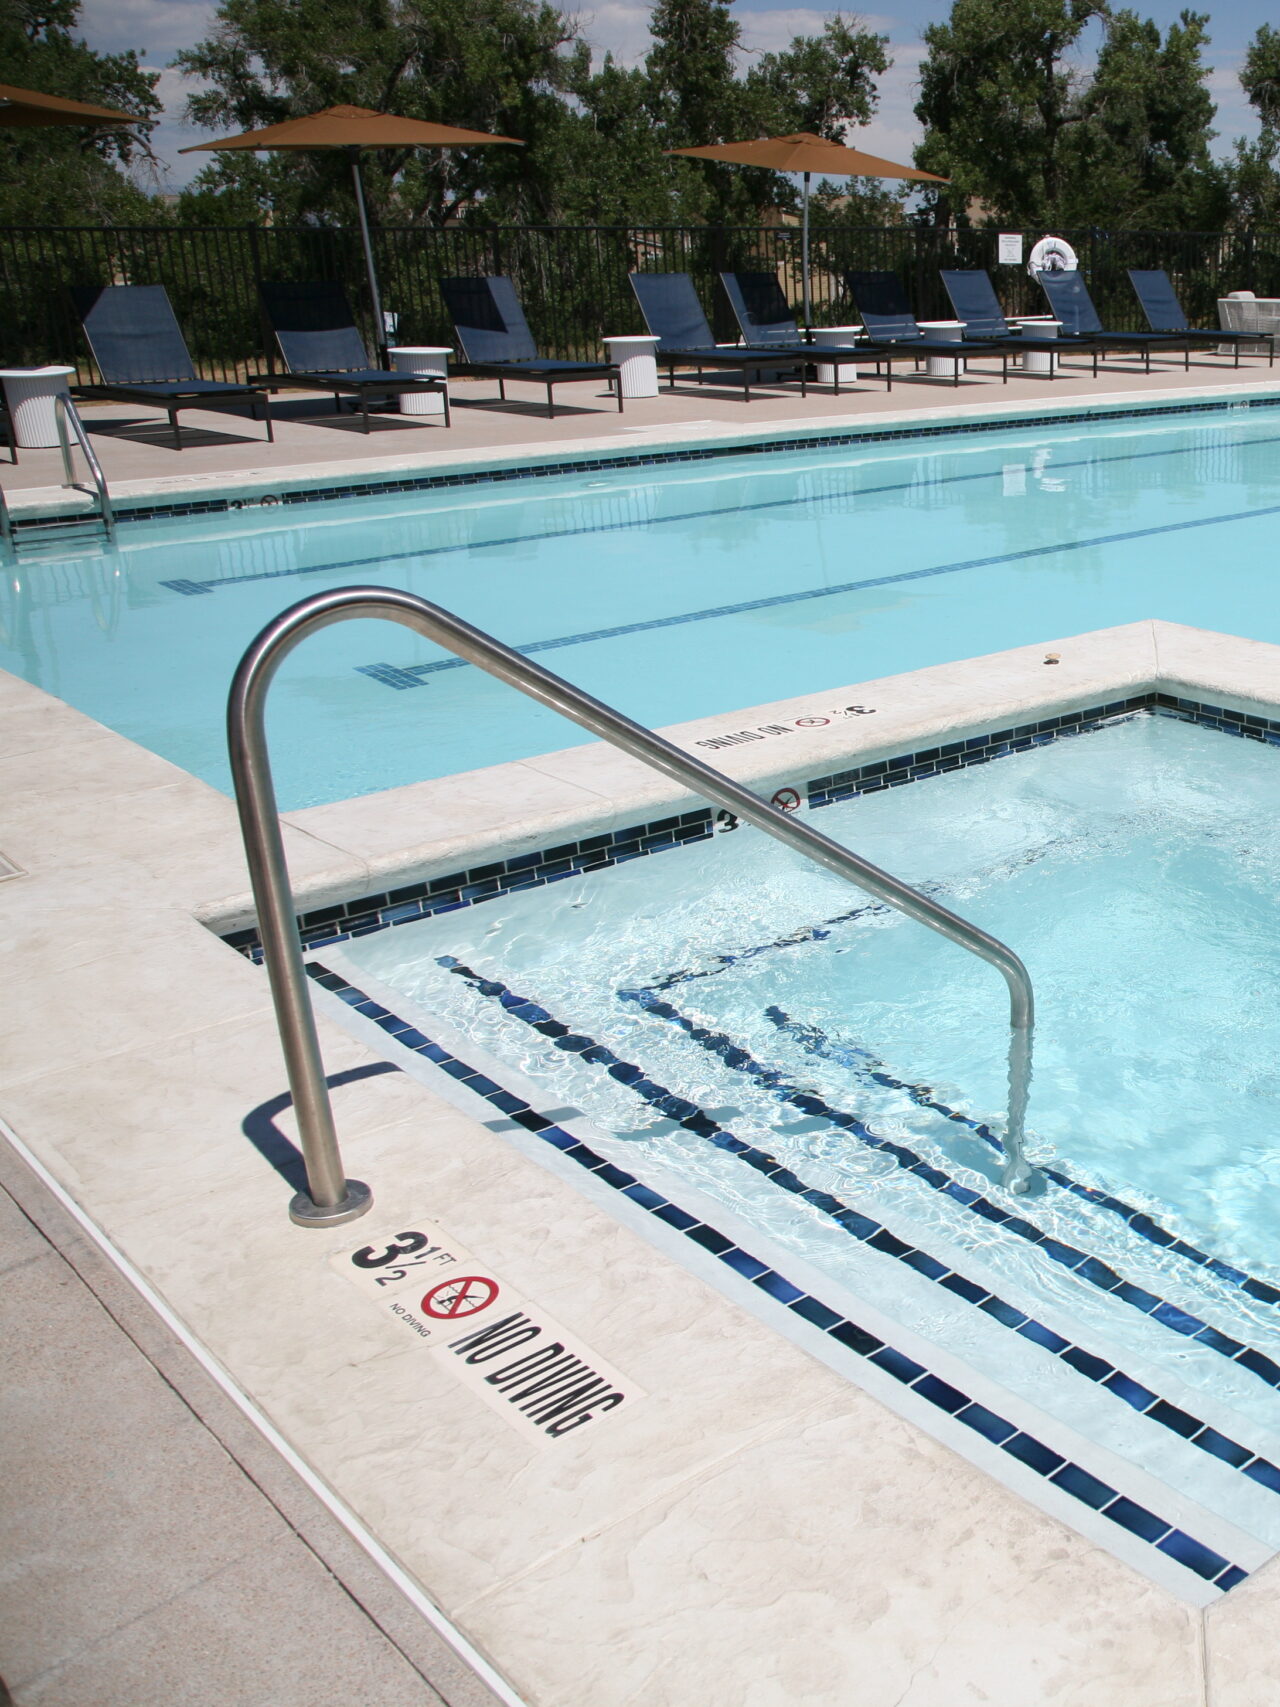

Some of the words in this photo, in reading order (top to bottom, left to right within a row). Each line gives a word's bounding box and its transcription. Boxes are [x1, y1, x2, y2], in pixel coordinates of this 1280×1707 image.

[695, 730, 766, 750] DIVING
[757, 724, 795, 736] NO
[716, 809, 740, 833] 3
[351, 1231, 429, 1269] 3
[432, 1252, 457, 1266] FT
[389, 1302, 406, 1315] NO
[402, 1313, 432, 1338] DIVING
[447, 1311, 542, 1365] NO
[484, 1342, 625, 1439] DIVING
